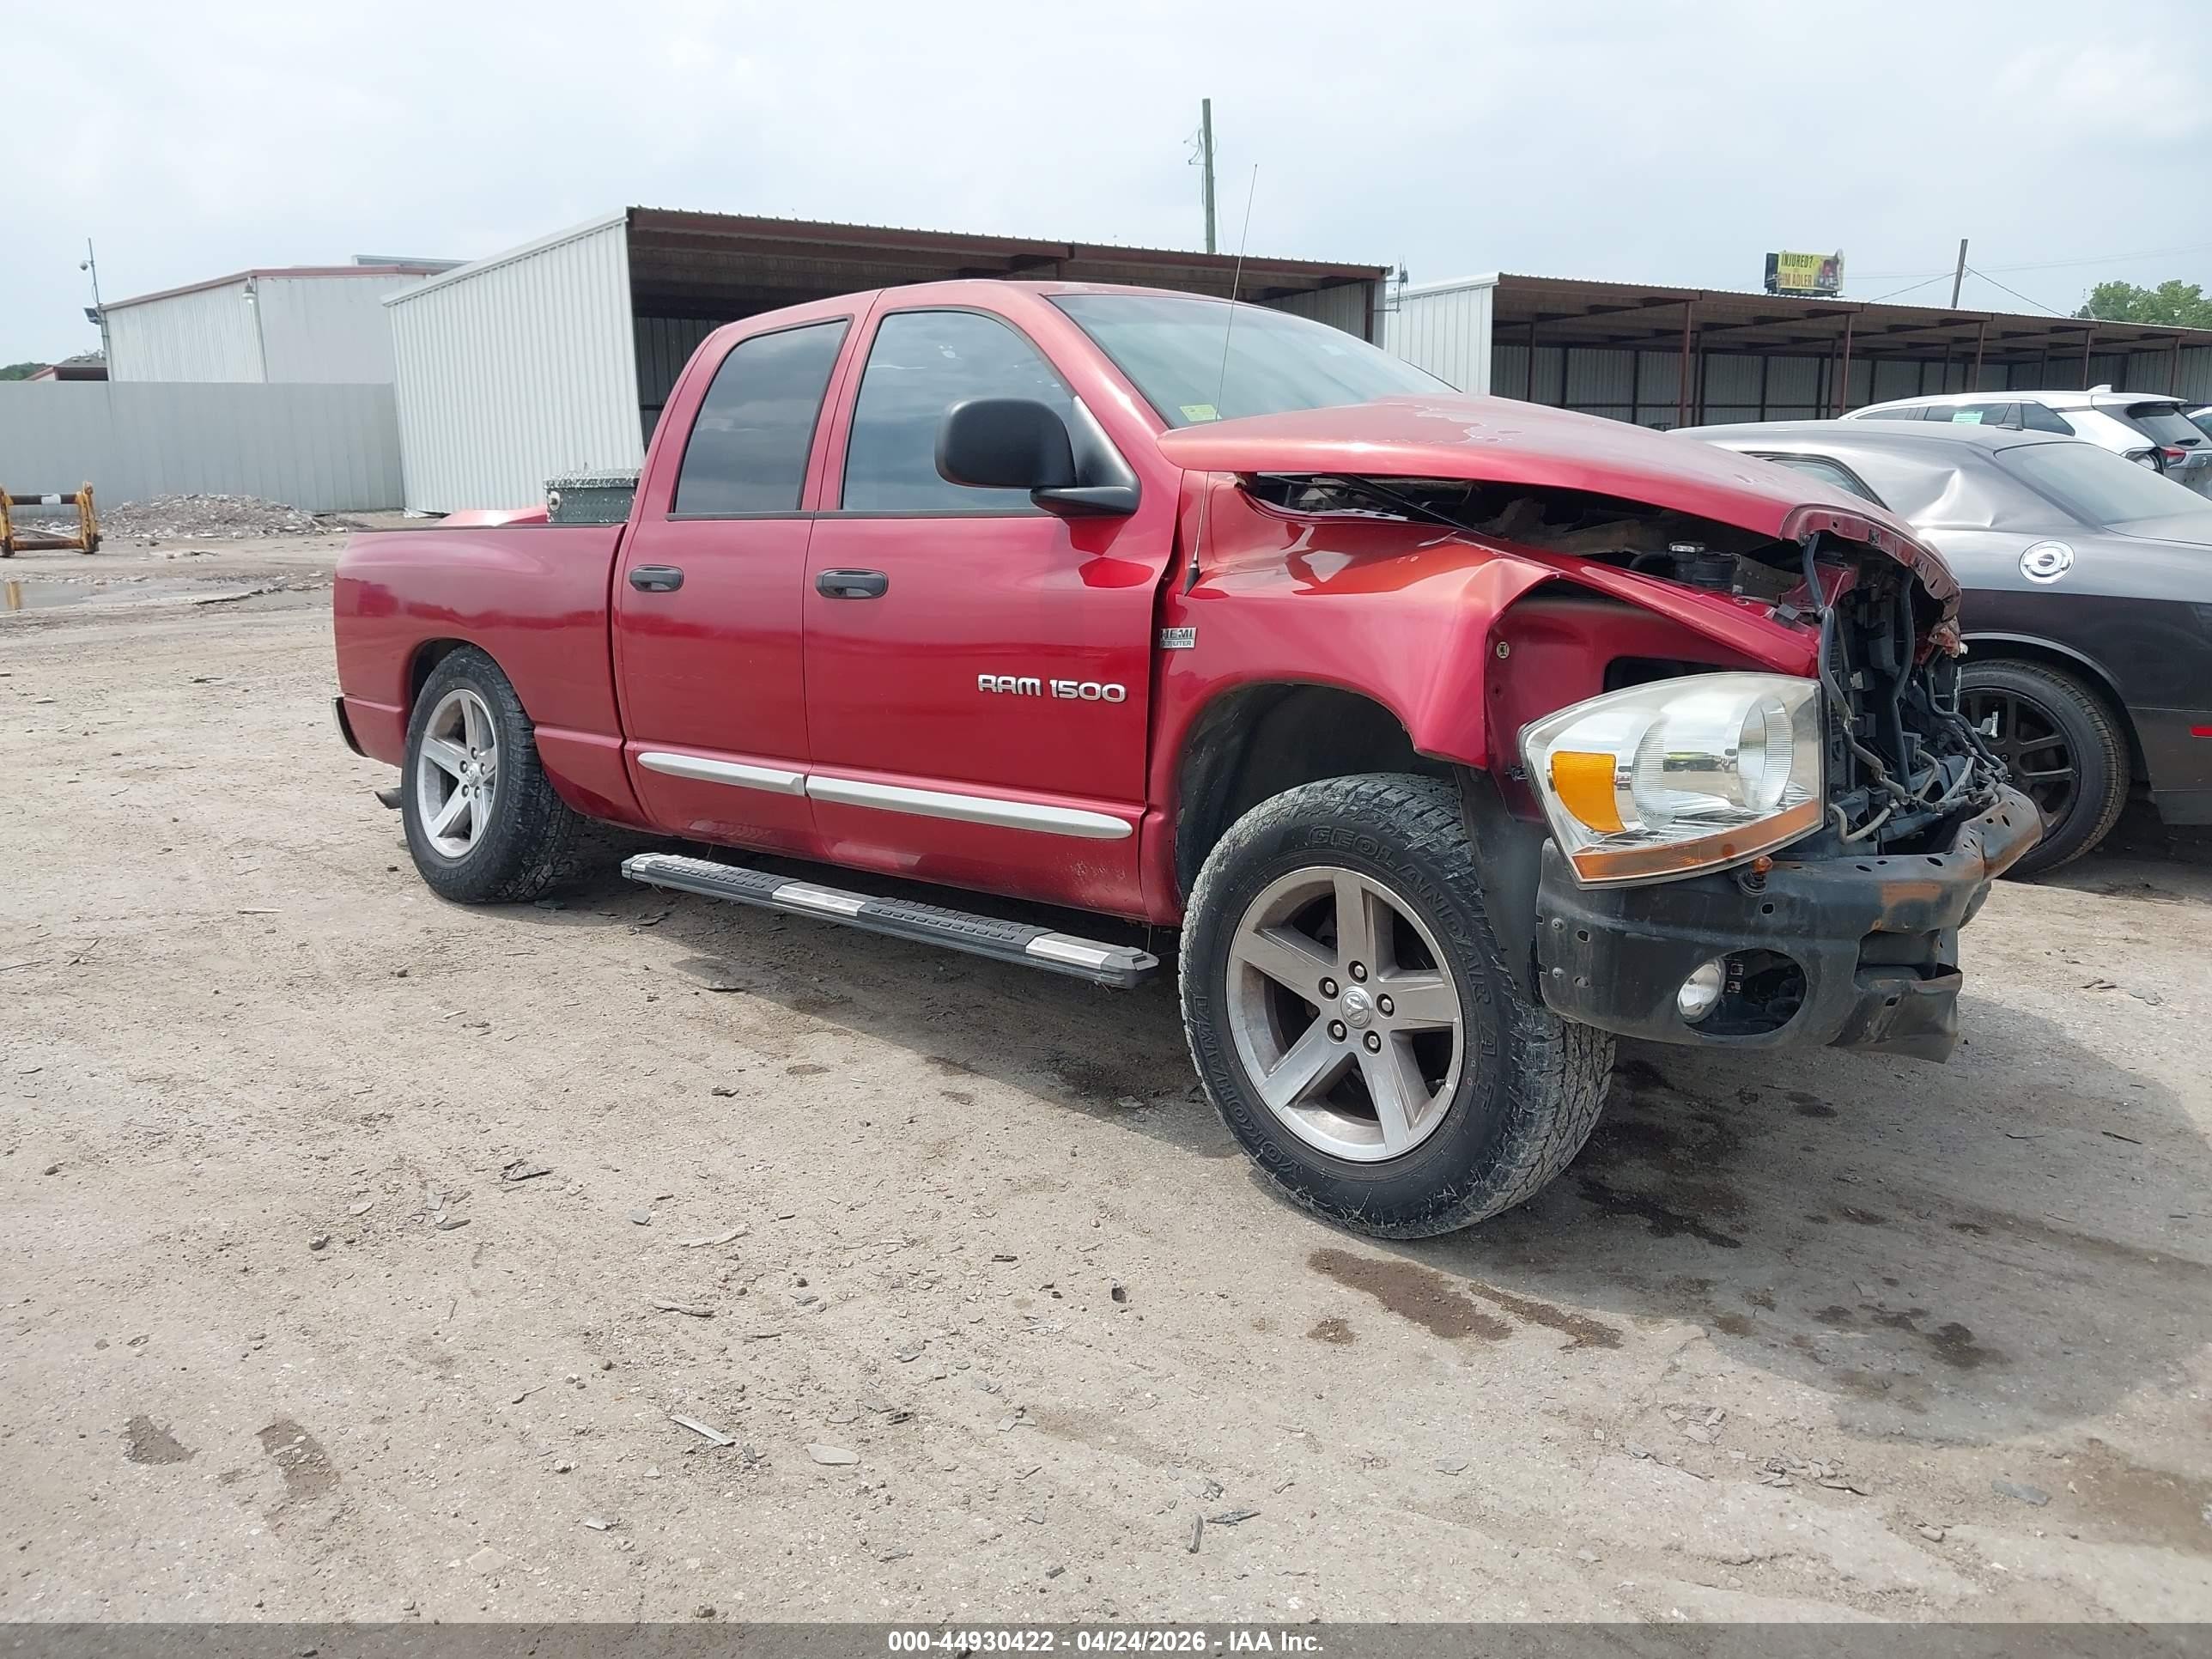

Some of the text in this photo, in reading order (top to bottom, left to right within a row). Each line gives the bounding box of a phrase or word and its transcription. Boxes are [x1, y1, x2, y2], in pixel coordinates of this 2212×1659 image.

[1781, 254, 1814, 268] INJURED?
[1160, 629, 1192, 639] HEMI
[978, 674, 1126, 702] RAM 1500
[1309, 825, 1492, 1005] GEOLANDAR
[1194, 994, 1302, 1180] YOKOHAMA
